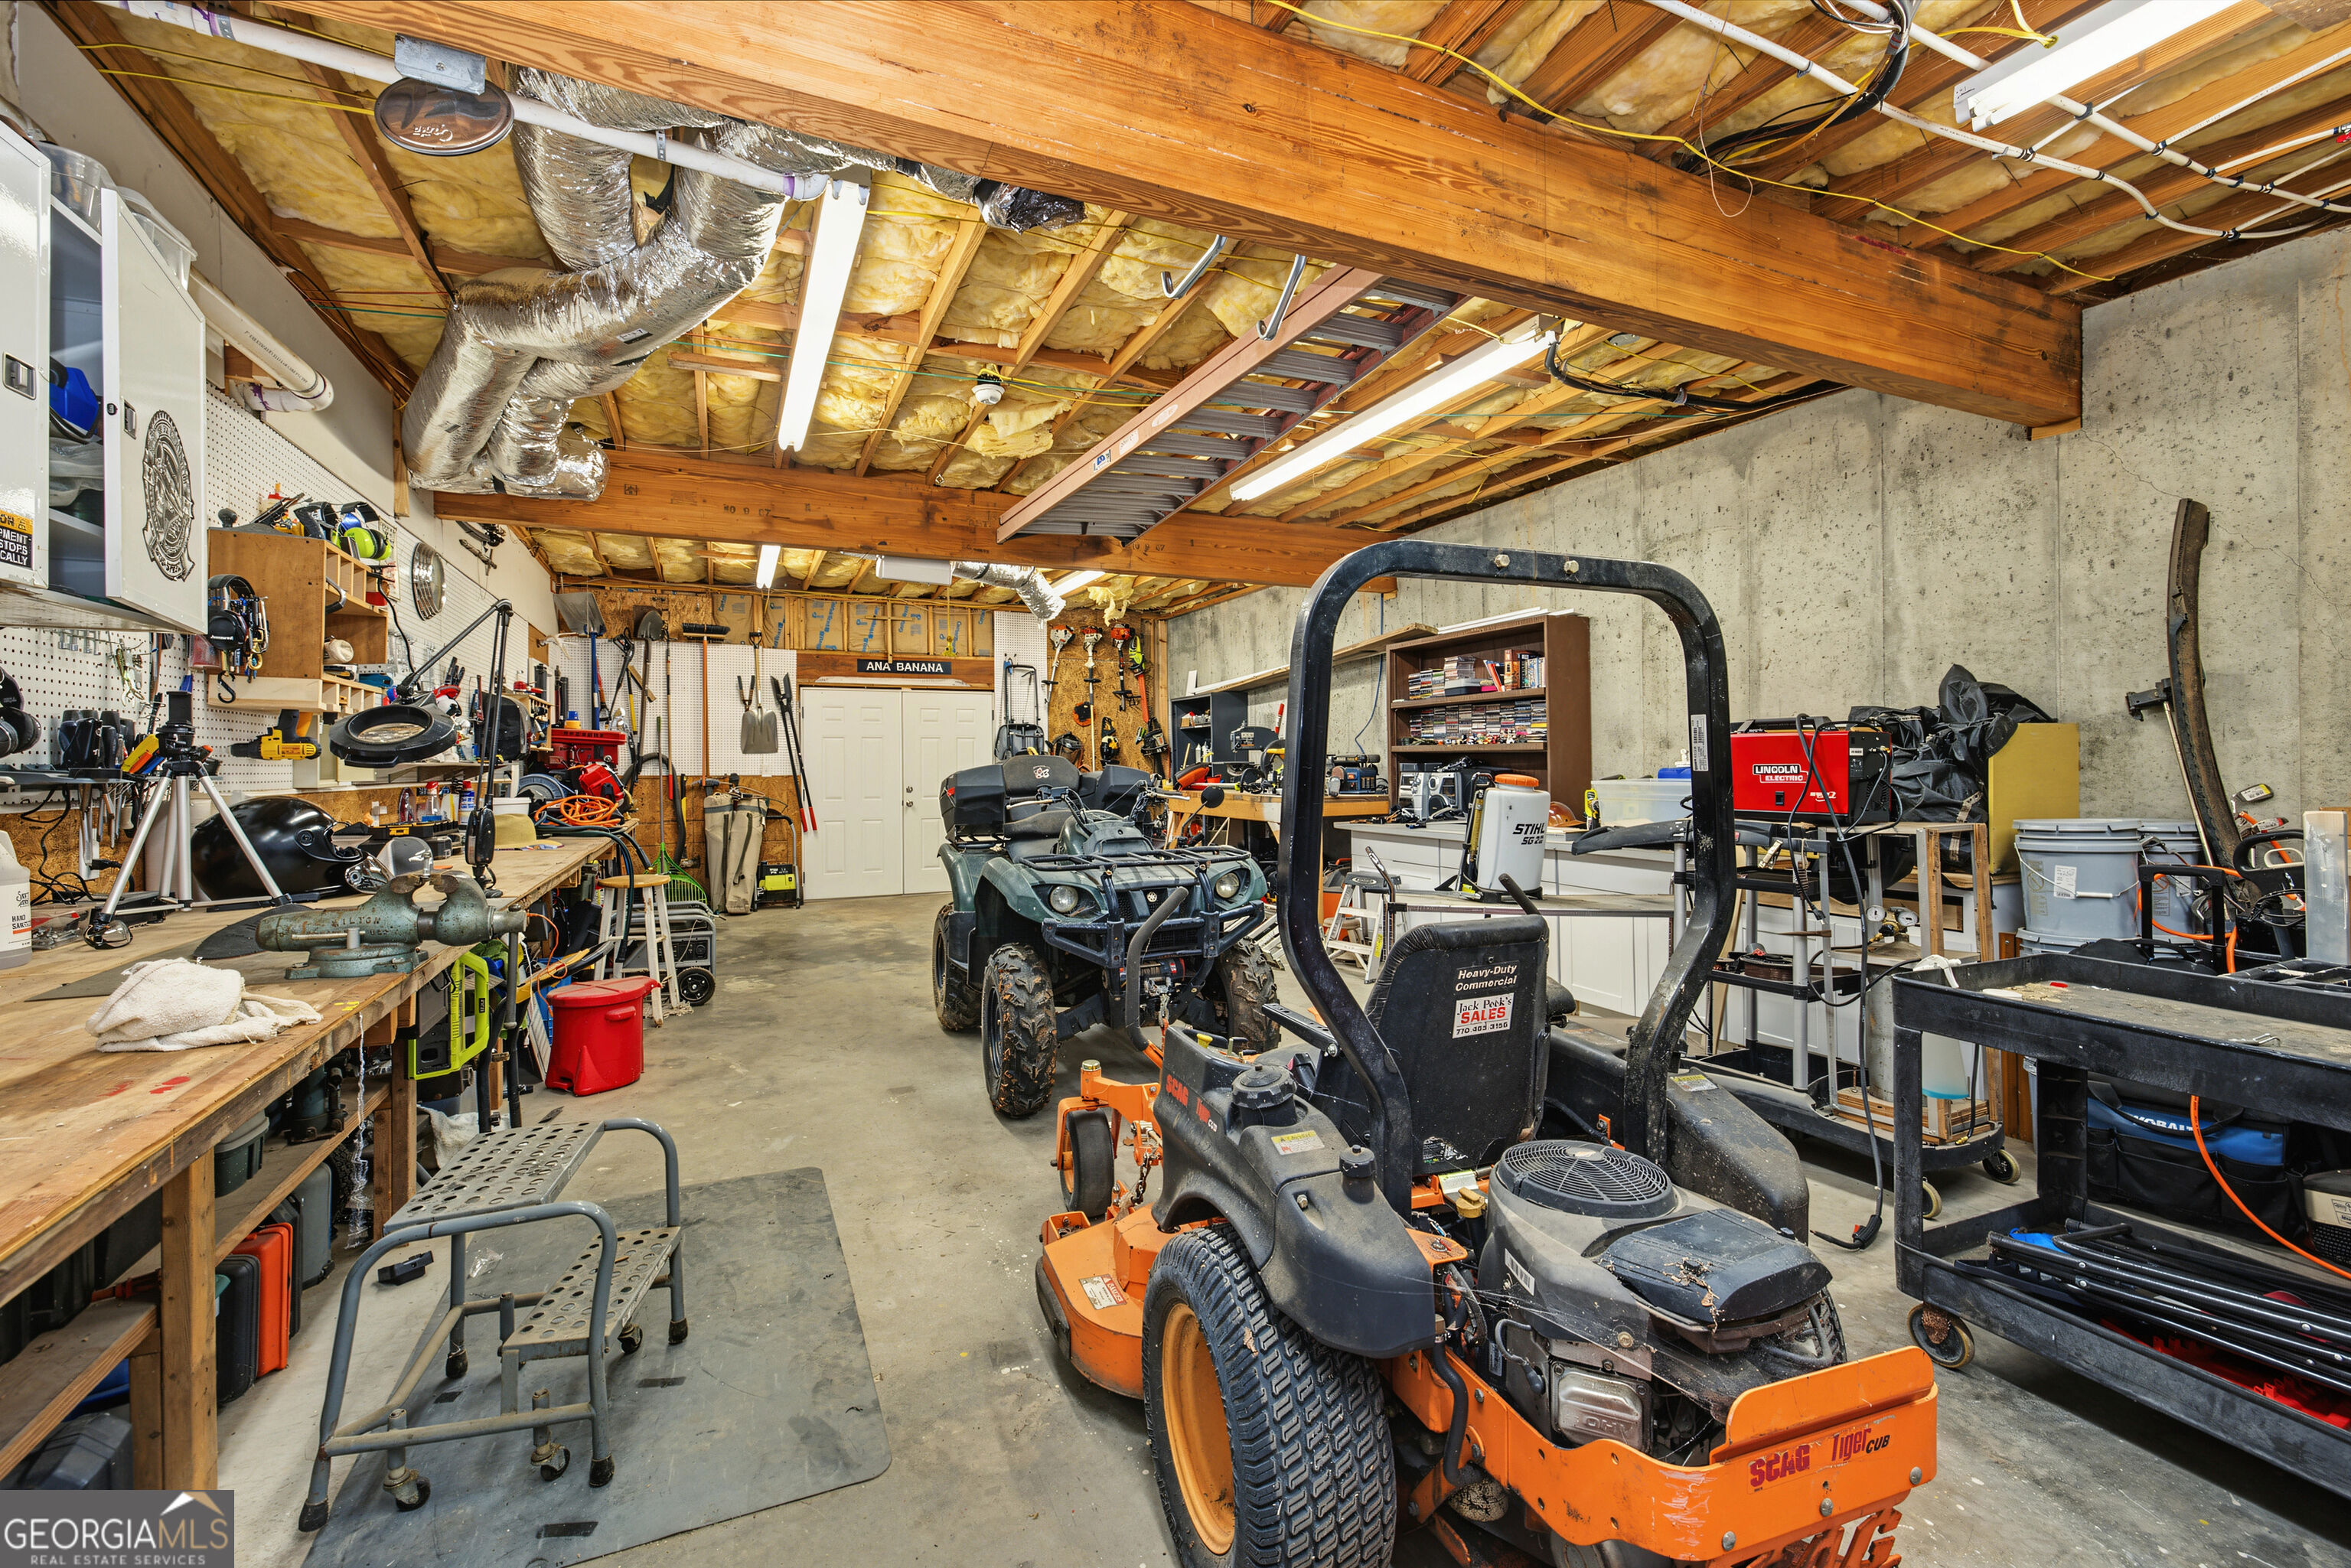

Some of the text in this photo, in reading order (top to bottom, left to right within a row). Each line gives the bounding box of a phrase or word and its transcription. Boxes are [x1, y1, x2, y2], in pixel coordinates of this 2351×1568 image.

[866, 661, 944, 673] ANA BANANA
[1755, 765, 1798, 774] LINCOLN
[1512, 823, 1544, 835] STIHL
[1521, 836, 1534, 845] SG
[1458, 965, 1517, 980] Heavy-Duty
[1455, 975, 1517, 992] Commercial
[1457, 1000, 1479, 1015] Jack
[1460, 1006, 1506, 1025] SALES
[1749, 1428, 1890, 1488] SCAG Tiger CUB
